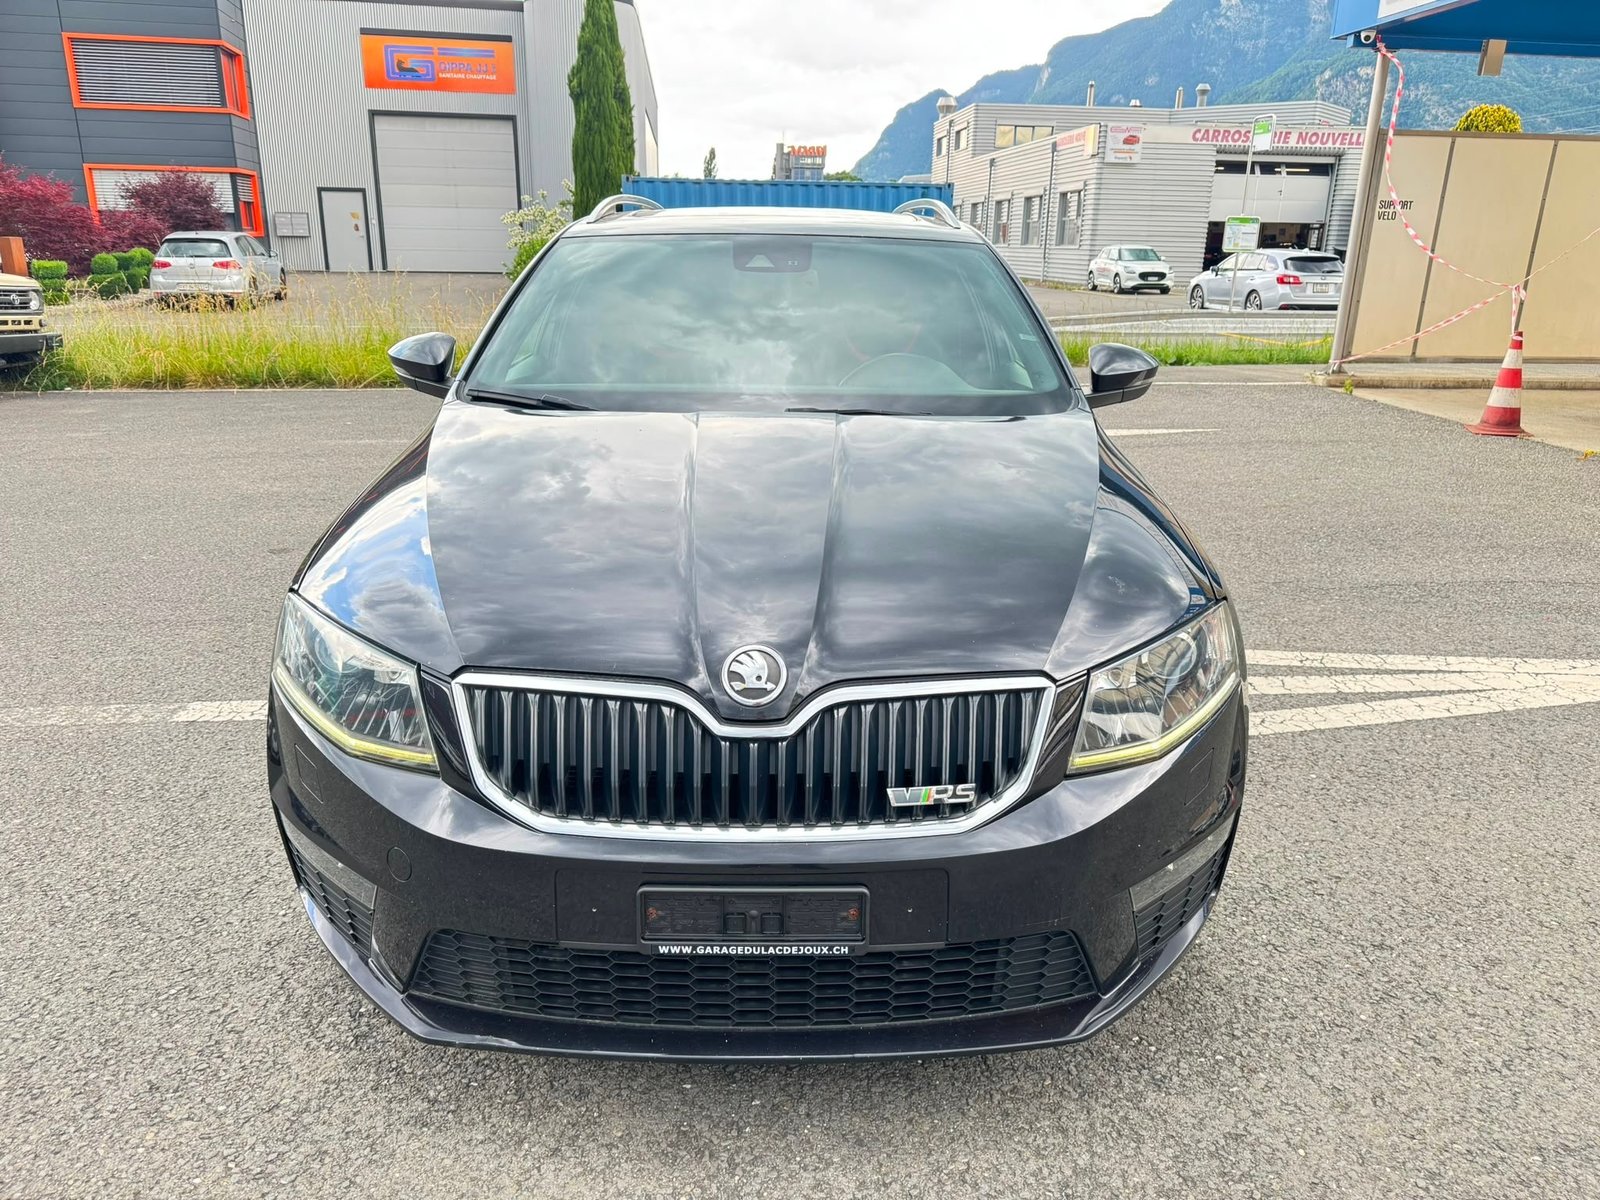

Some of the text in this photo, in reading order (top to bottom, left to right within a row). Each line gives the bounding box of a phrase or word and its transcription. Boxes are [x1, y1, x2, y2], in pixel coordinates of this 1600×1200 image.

[1192, 128, 1366, 147] CARROSIE NOUVELL
[1378, 211, 1397, 221] VELO
[658, 945, 849, 955] WWW.GARAGEDULACDEJOUX.CH
